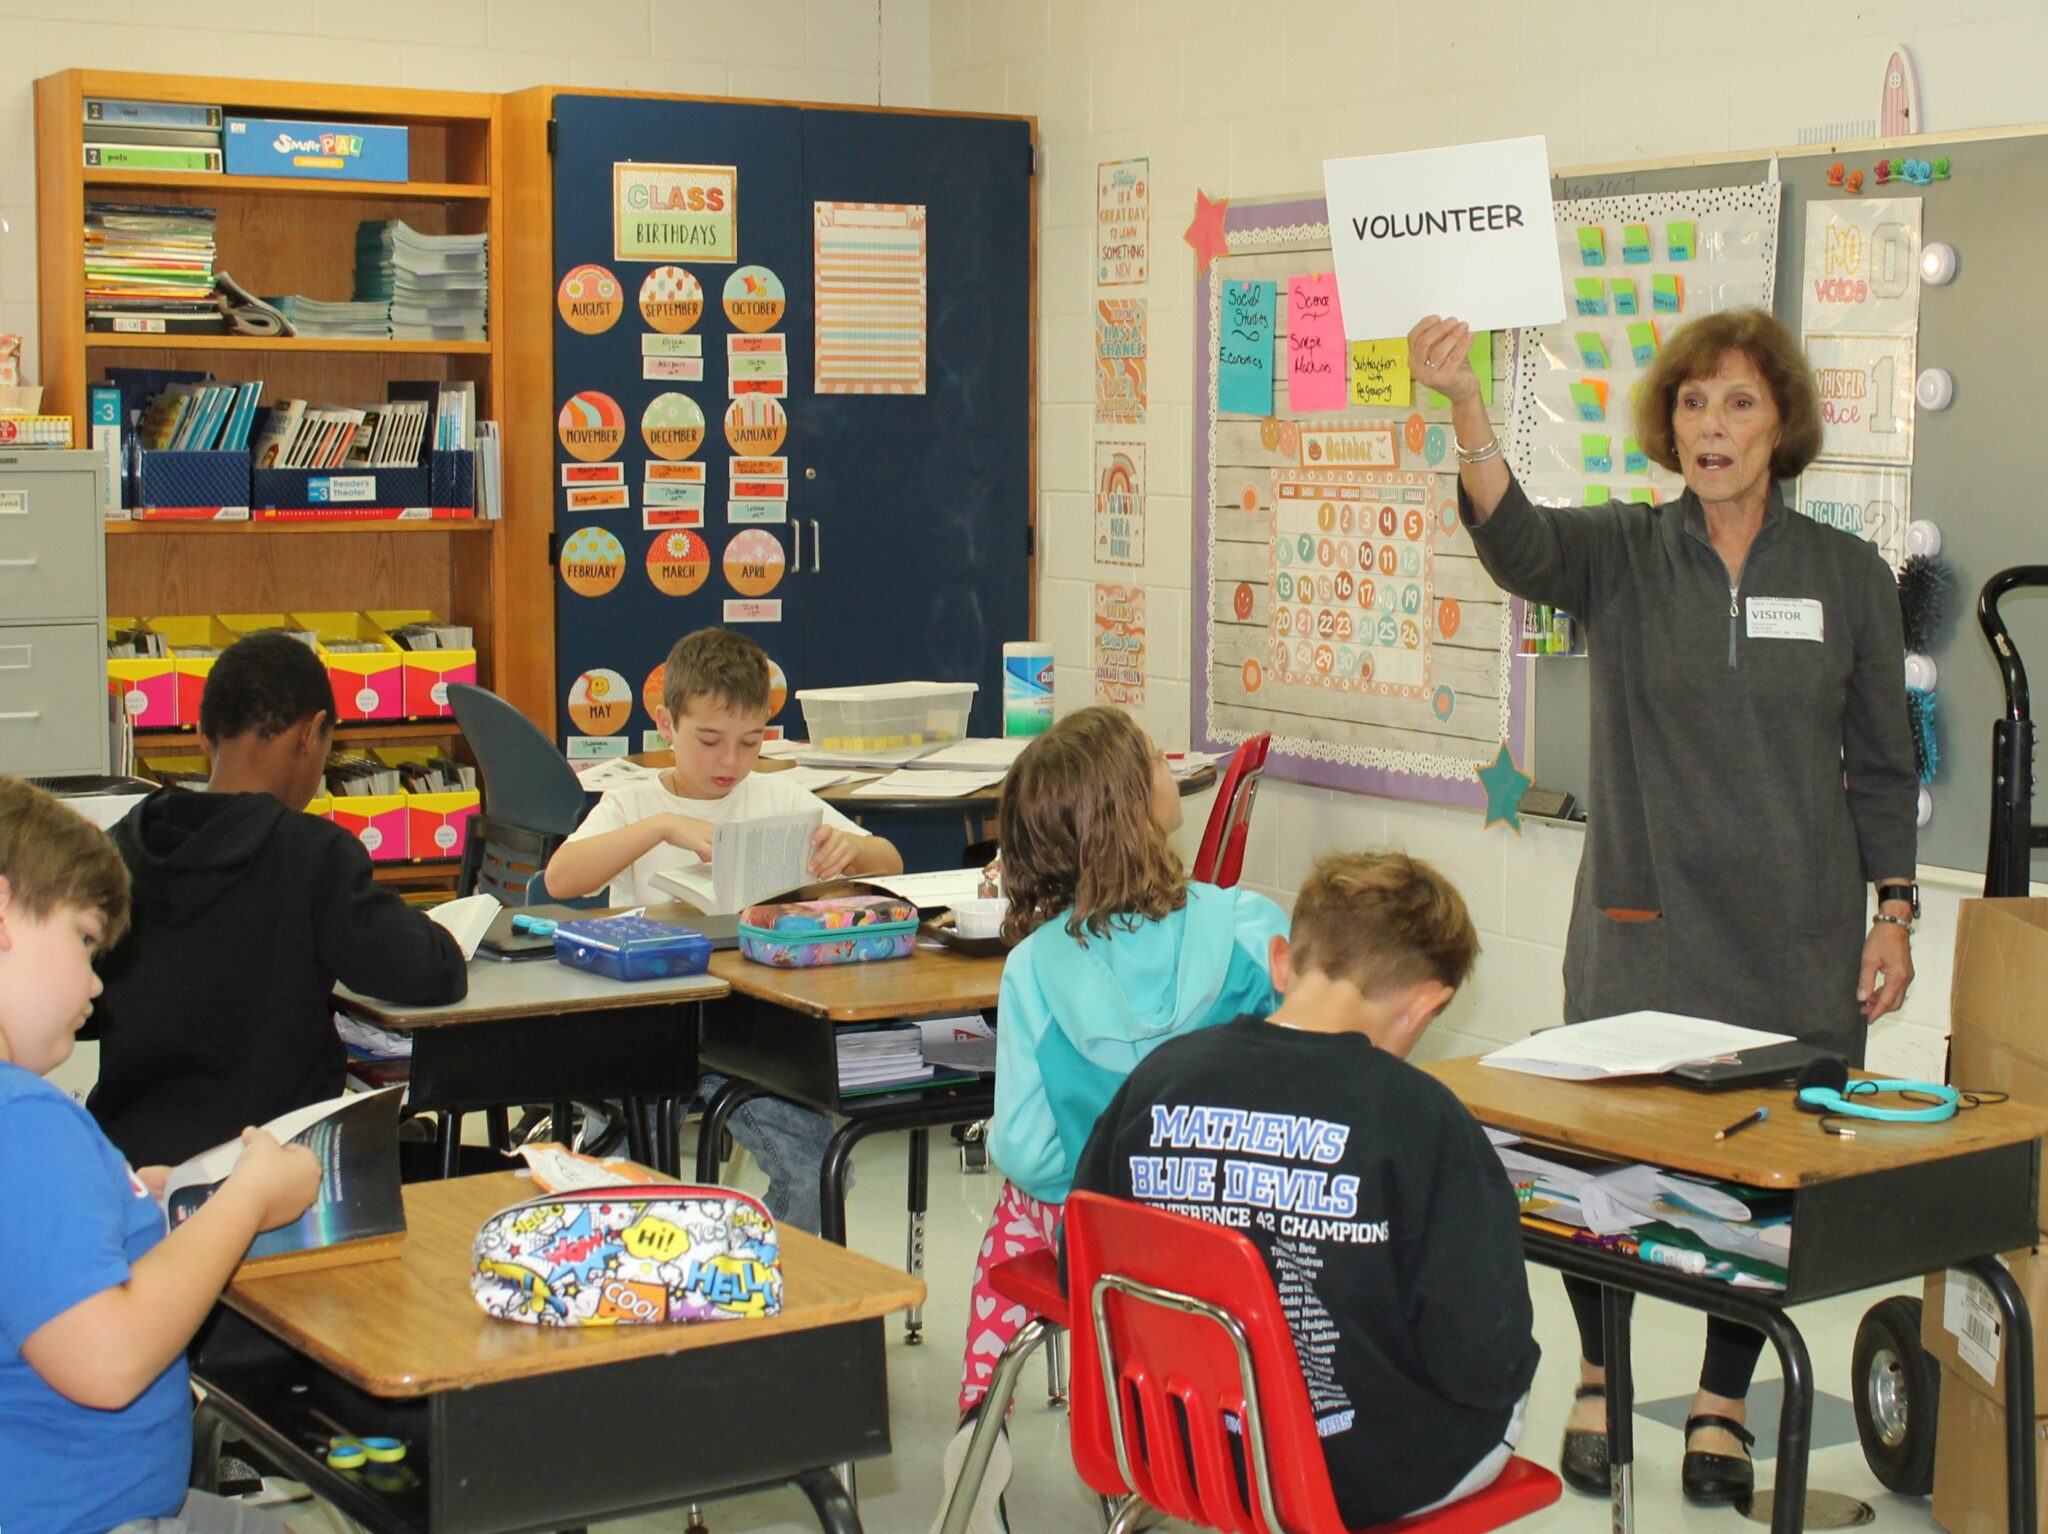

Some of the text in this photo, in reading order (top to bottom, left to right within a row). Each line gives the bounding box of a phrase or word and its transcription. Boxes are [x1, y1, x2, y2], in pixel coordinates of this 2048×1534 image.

[627, 184, 724, 212] CLASS
[1128, 207, 1146, 221] DAY
[1352, 204, 1524, 241] VOLUNTEER
[636, 223, 717, 246] BIRTHDAYS
[1102, 244, 1145, 261] SOMETHING
[571, 302, 611, 316] AUGUST
[645, 303, 699, 318] SEPTEMBER
[732, 302, 777, 317] OCTOBER
[1100, 341, 1145, 357] CHANCE
[1822, 401, 1861, 425] oice
[566, 429, 618, 444] NOVEMBER
[650, 429, 697, 445] DECEMBER
[734, 428, 778, 444] JANUARY
[1325, 435, 1373, 462] October
[1342, 511, 1349, 527] 2
[1362, 511, 1371, 527] 3
[1383, 512, 1392, 530] 4
[1408, 515, 1418, 534] 5
[1303, 538, 1310, 554] 7
[1322, 544, 1329, 560] 8
[1341, 547, 1348, 564] 9
[1361, 547, 1373, 565] 10
[1382, 551, 1393, 570] 11
[1403, 552, 1416, 571] 12
[567, 564, 617, 579] FEBRUARY
[662, 565, 695, 578] MARCH
[741, 565, 766, 578] APRIL
[1279, 578, 1291, 594] 13
[1300, 580, 1312, 598] 14
[1319, 581, 1330, 598] 15
[1337, 577, 1351, 595] 16
[1359, 584, 1372, 603] 17
[1404, 590, 1418, 608] 19
[1752, 610, 1801, 620] VISITOR
[1276, 612, 1417, 643] 20 21 22 23 24 25 26
[1297, 646, 1312, 663] 28
[1316, 650, 1332, 667] 29
[1338, 653, 1351, 671] 30
[590, 705, 611, 718] MAY
[1150, 1104, 1350, 1164] MATHEWS
[1129, 1156, 1360, 1218] BLUE DEVILS
[1146, 1202, 1389, 1243] FERENCE 42 CHAMPIONS
[638, 1228, 675, 1252] Hi!
